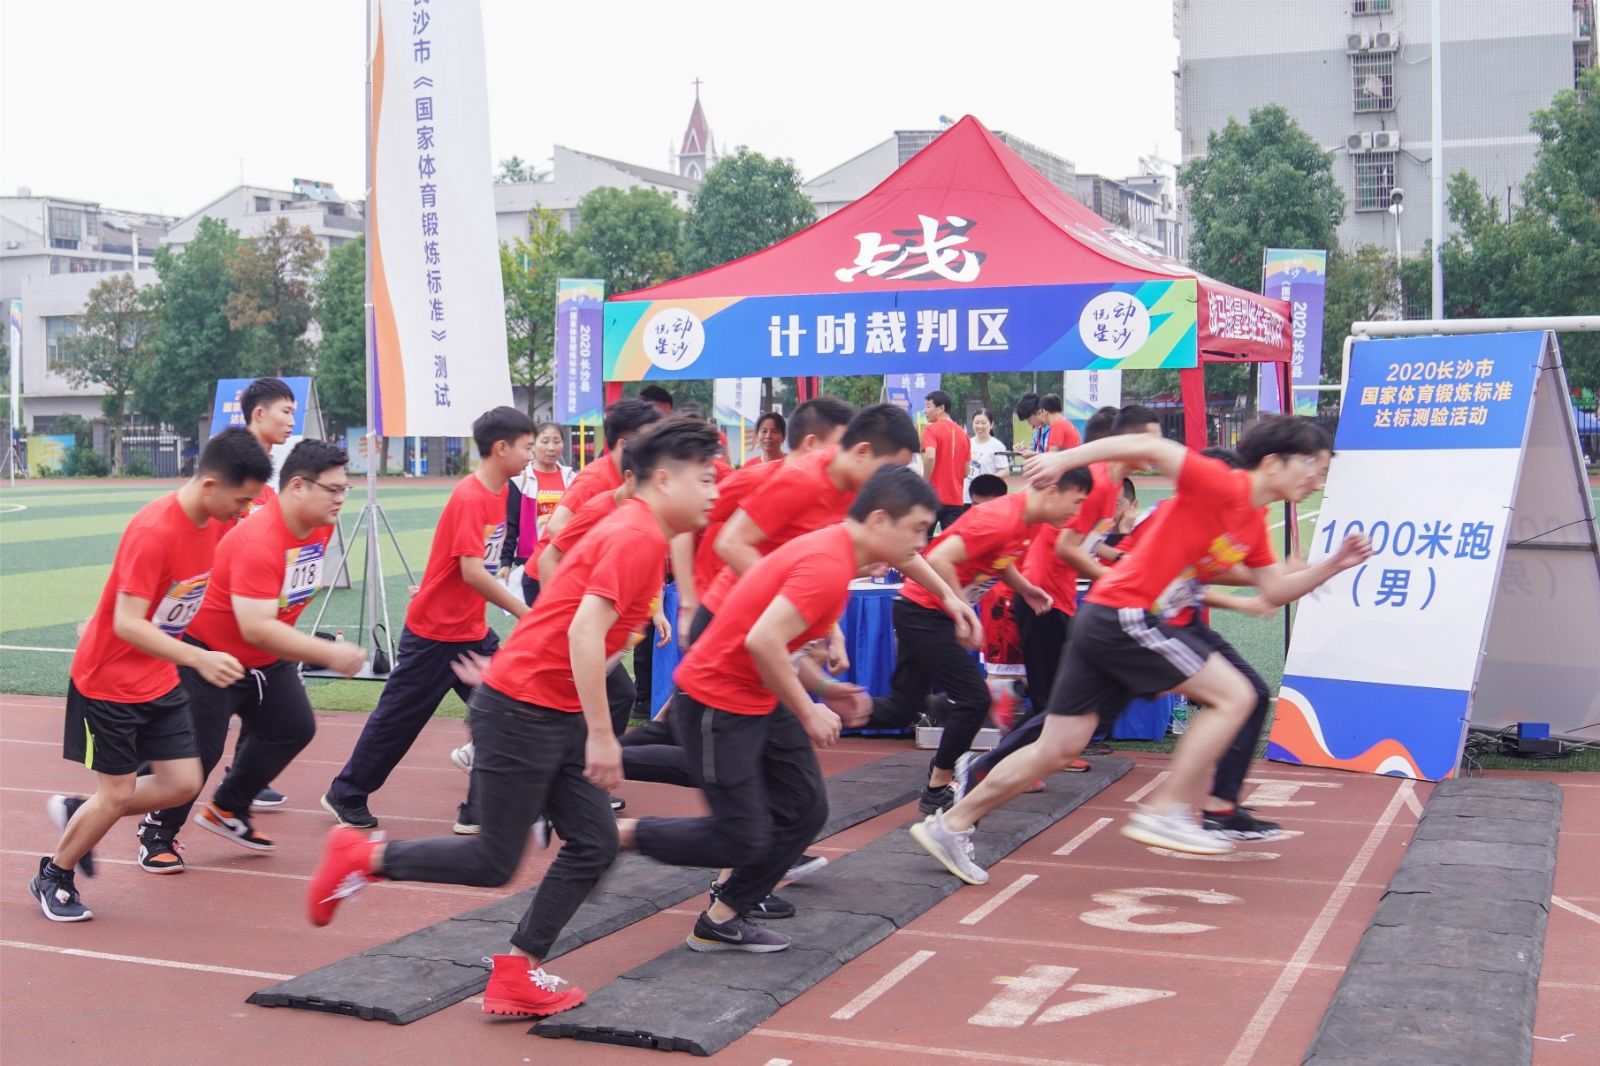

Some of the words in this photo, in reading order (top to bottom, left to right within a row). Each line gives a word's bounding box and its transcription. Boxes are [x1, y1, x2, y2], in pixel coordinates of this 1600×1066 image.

[767, 308, 1009, 357] 计时裁判区
[1386, 358, 1496, 382] 2020长沙市
[1360, 380, 1514, 406] 国家体育锻炼标准
[1373, 405, 1489, 428] 达标测验活动
[290, 563, 316, 589] 018
[1079, 887, 1245, 934] 3
[967, 964, 1177, 1029] 4
